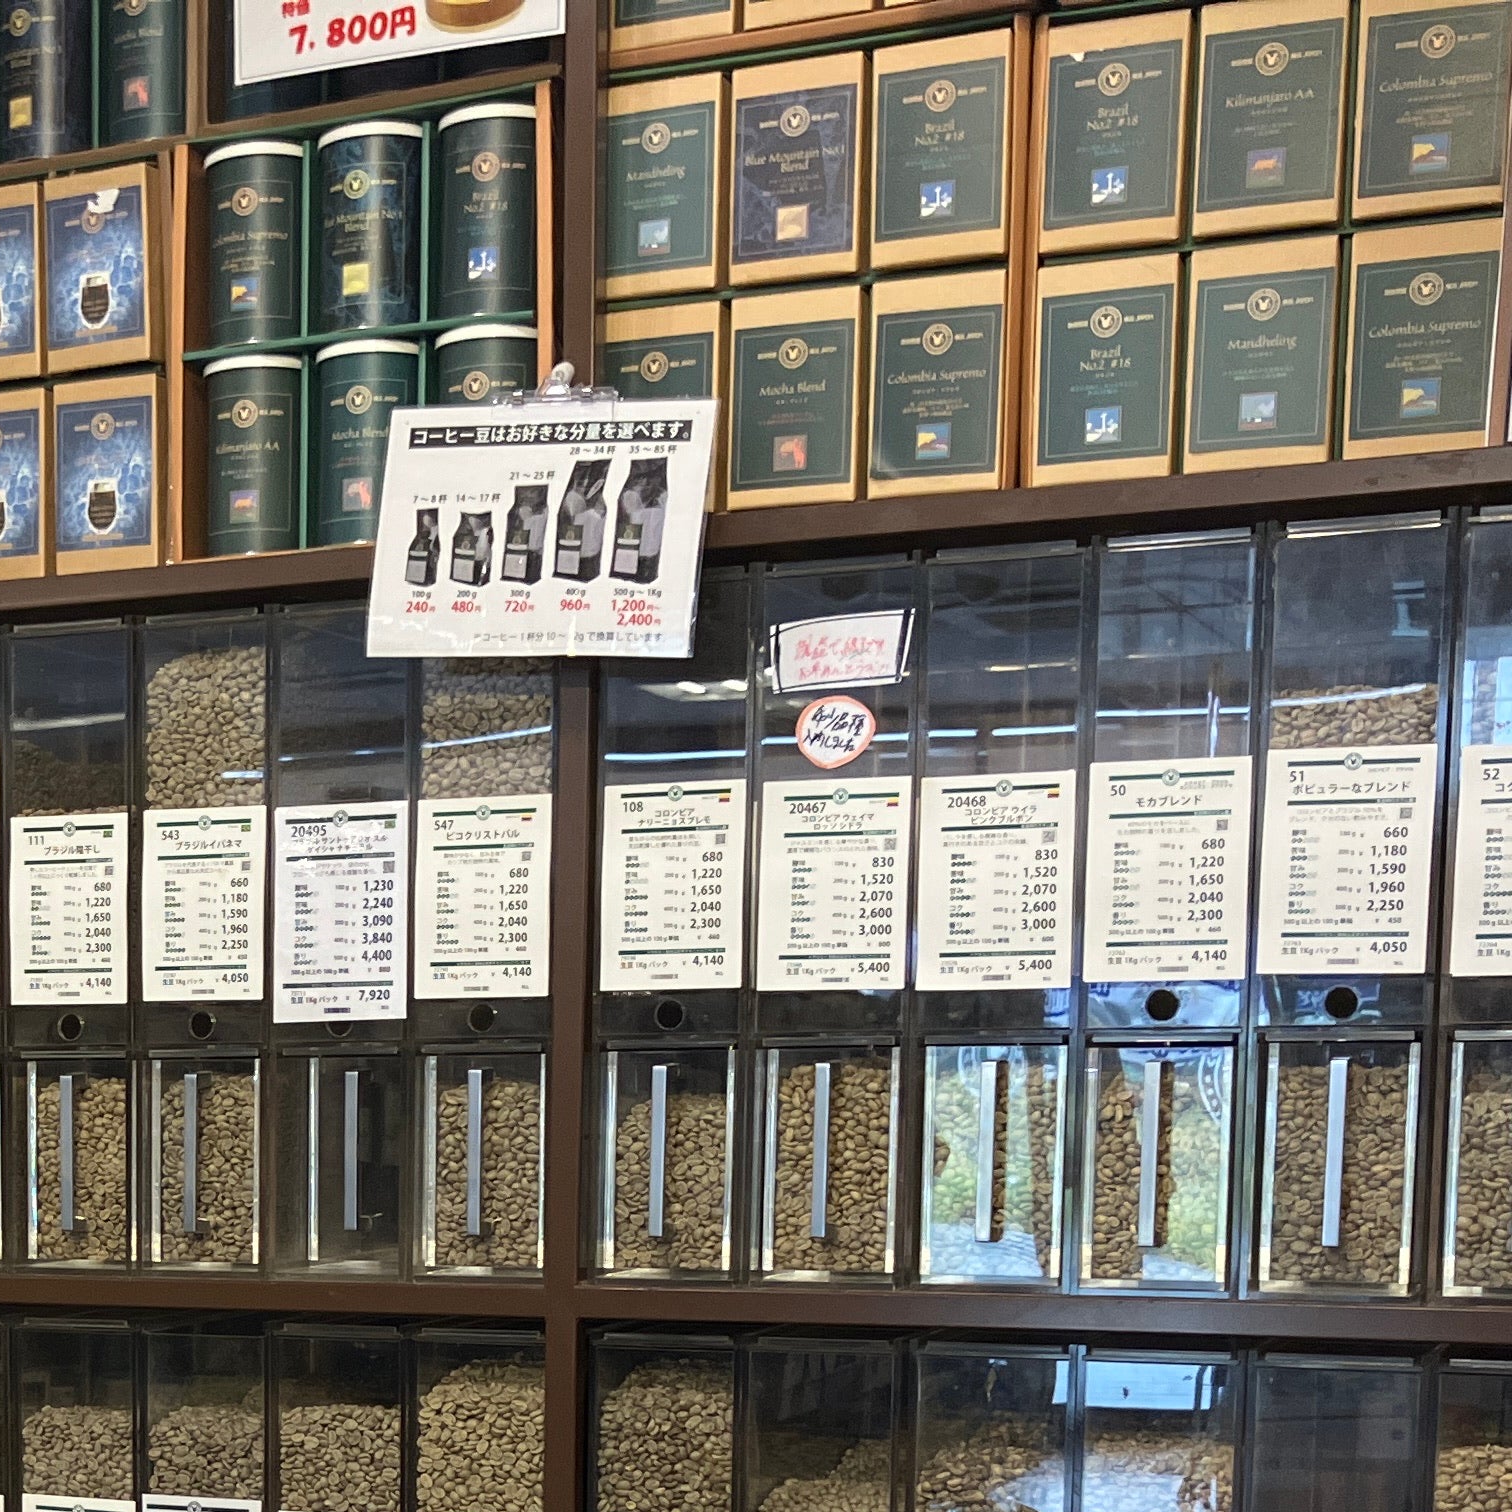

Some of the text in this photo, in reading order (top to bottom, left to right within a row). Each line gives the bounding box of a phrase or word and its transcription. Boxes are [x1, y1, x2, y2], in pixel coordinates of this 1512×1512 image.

[1294, 89, 1315, 100] AA
[1369, 318, 1482, 339] Colombia Supremo
[1228, 334, 1297, 350] Mandheling
[888, 371, 937, 385] Colombia
[759, 381, 826, 397] Mocha Blend
[1289, 770, 1305, 782] 51
[947, 796, 986, 808] 20468
[1136, 795, 1203, 807] モカブレンド
[790, 802, 826, 814] 20467
[291, 825, 327, 837] 20495
[1368, 881, 1405, 893] 1,960
[1370, 941, 1407, 953] 4,050
[692, 955, 724, 966] 4,140
